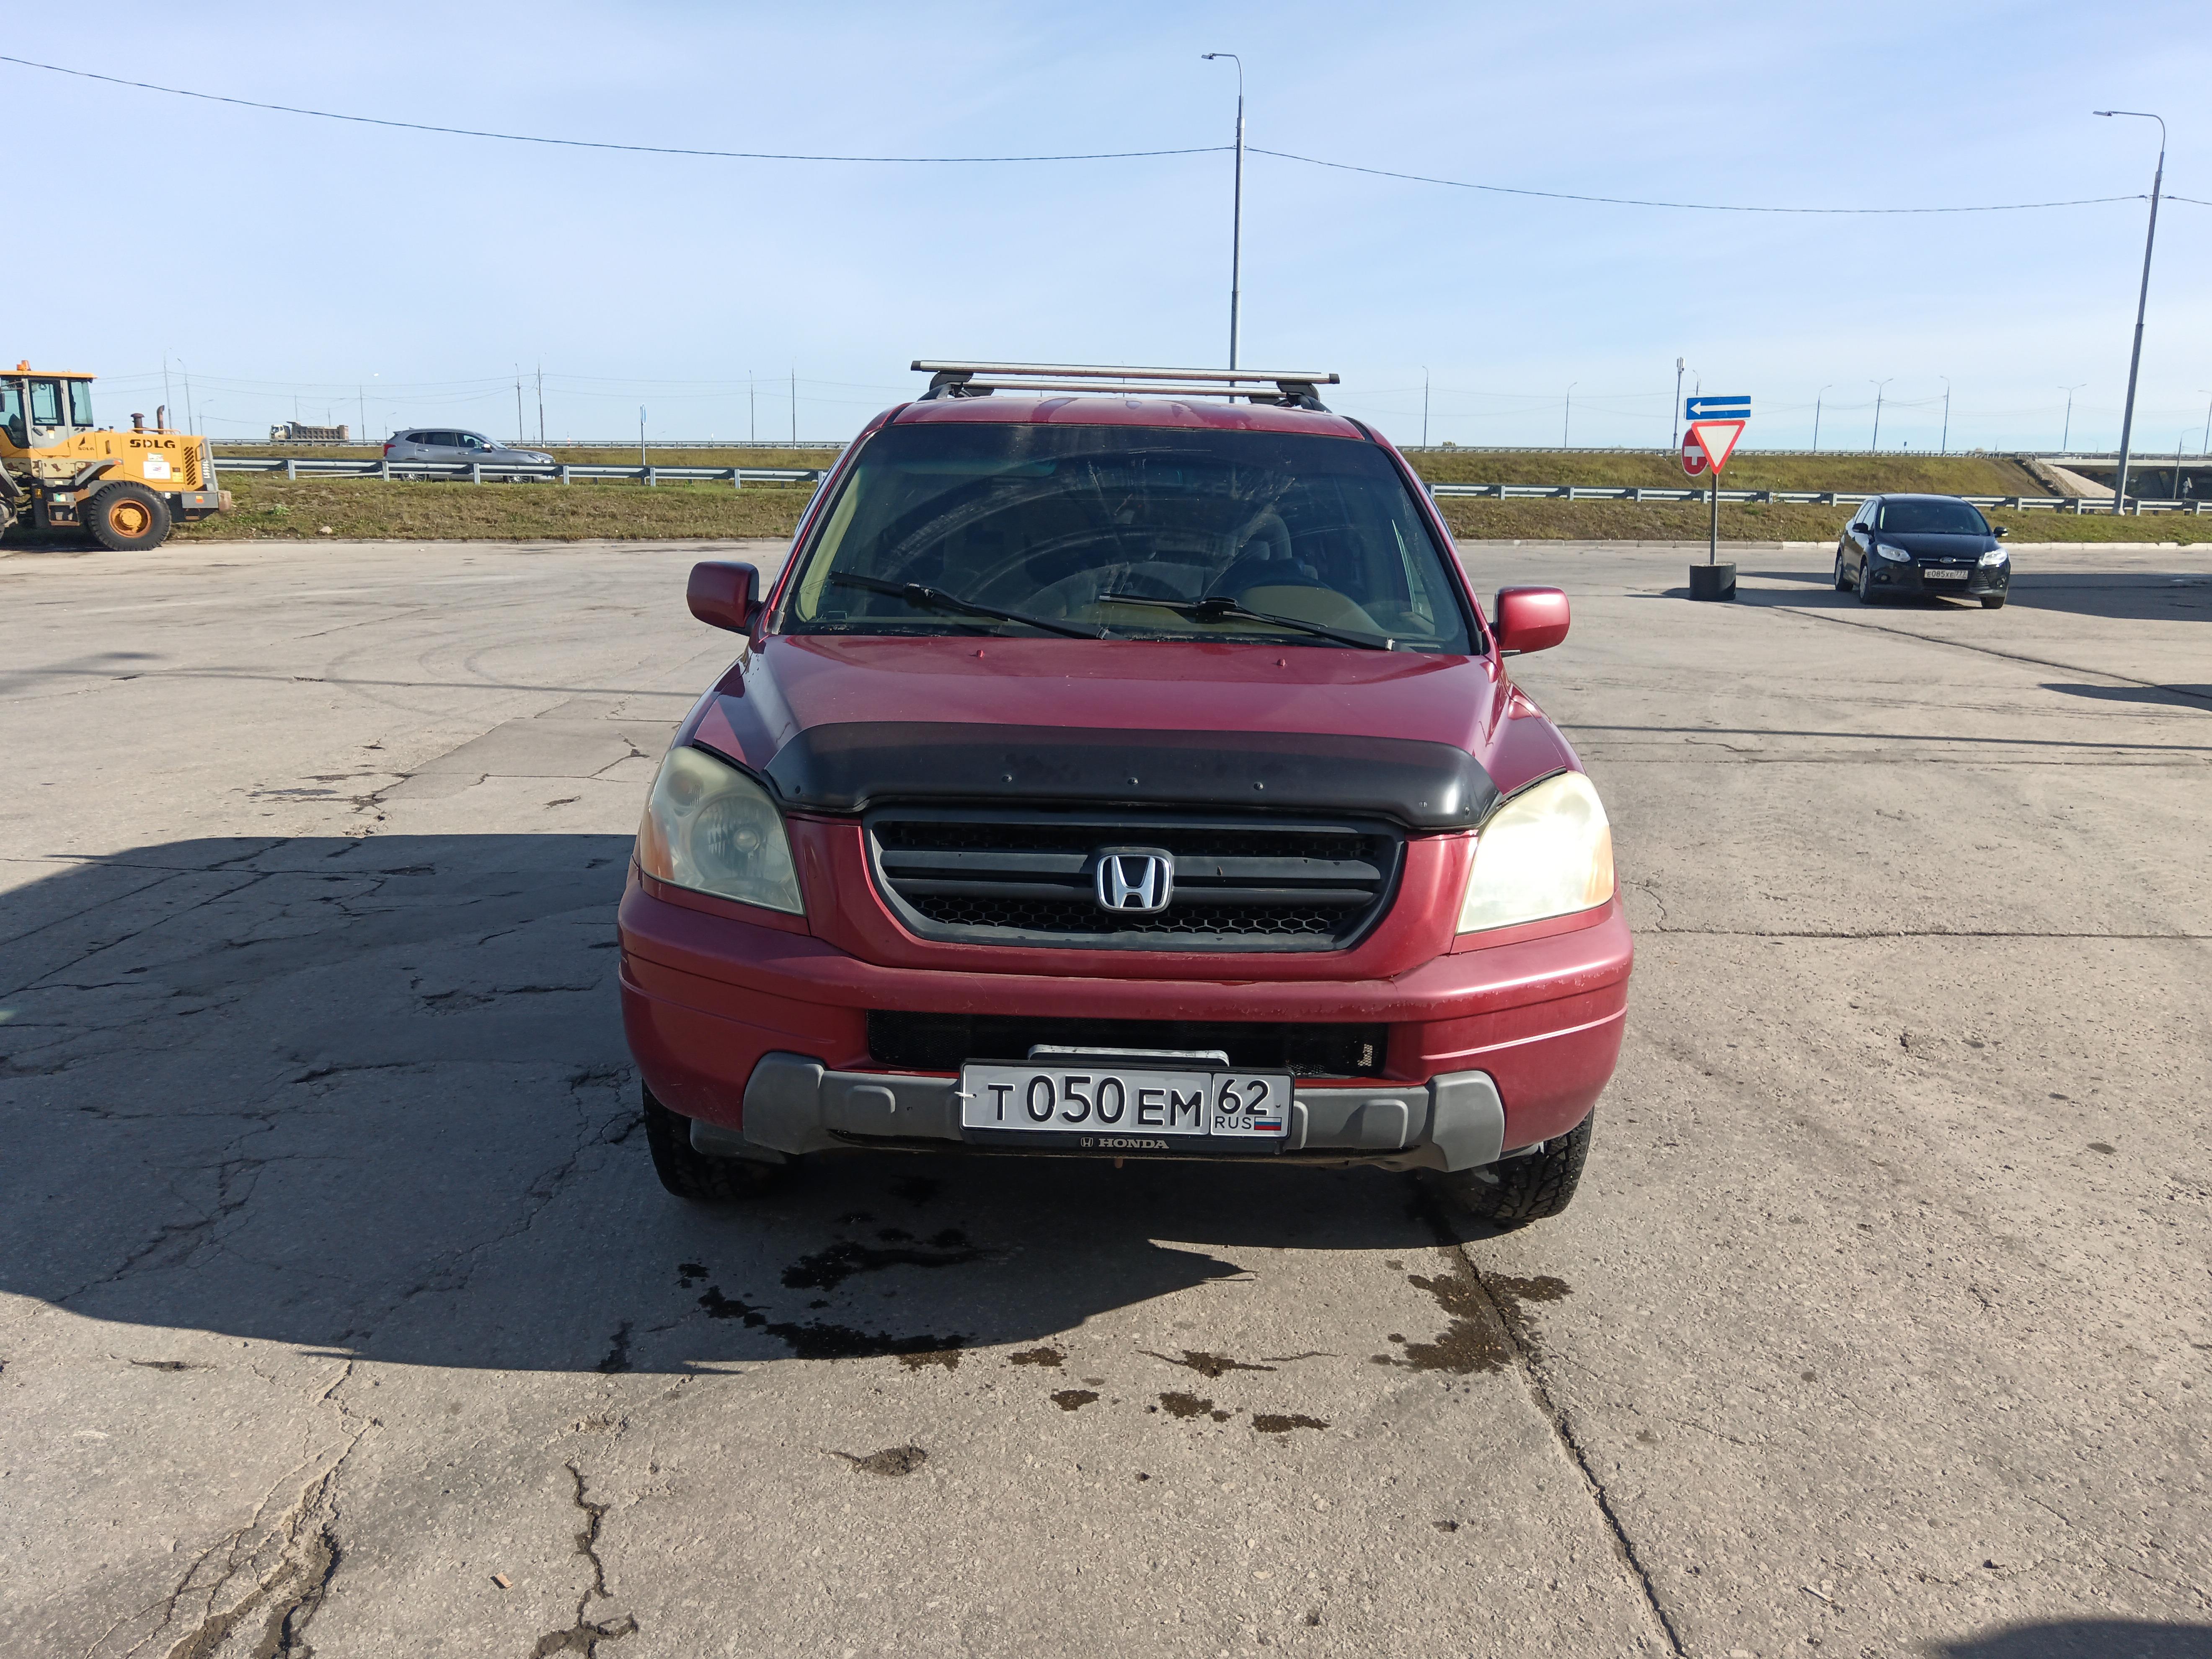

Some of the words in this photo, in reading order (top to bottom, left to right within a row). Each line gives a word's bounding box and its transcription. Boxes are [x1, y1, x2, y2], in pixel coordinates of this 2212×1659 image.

[129, 439, 176, 448] SDLG
[1218, 1078, 1270, 1116] 62
[1215, 1116, 1252, 1129] RUS
[1098, 1138, 1170, 1149] HONDA
